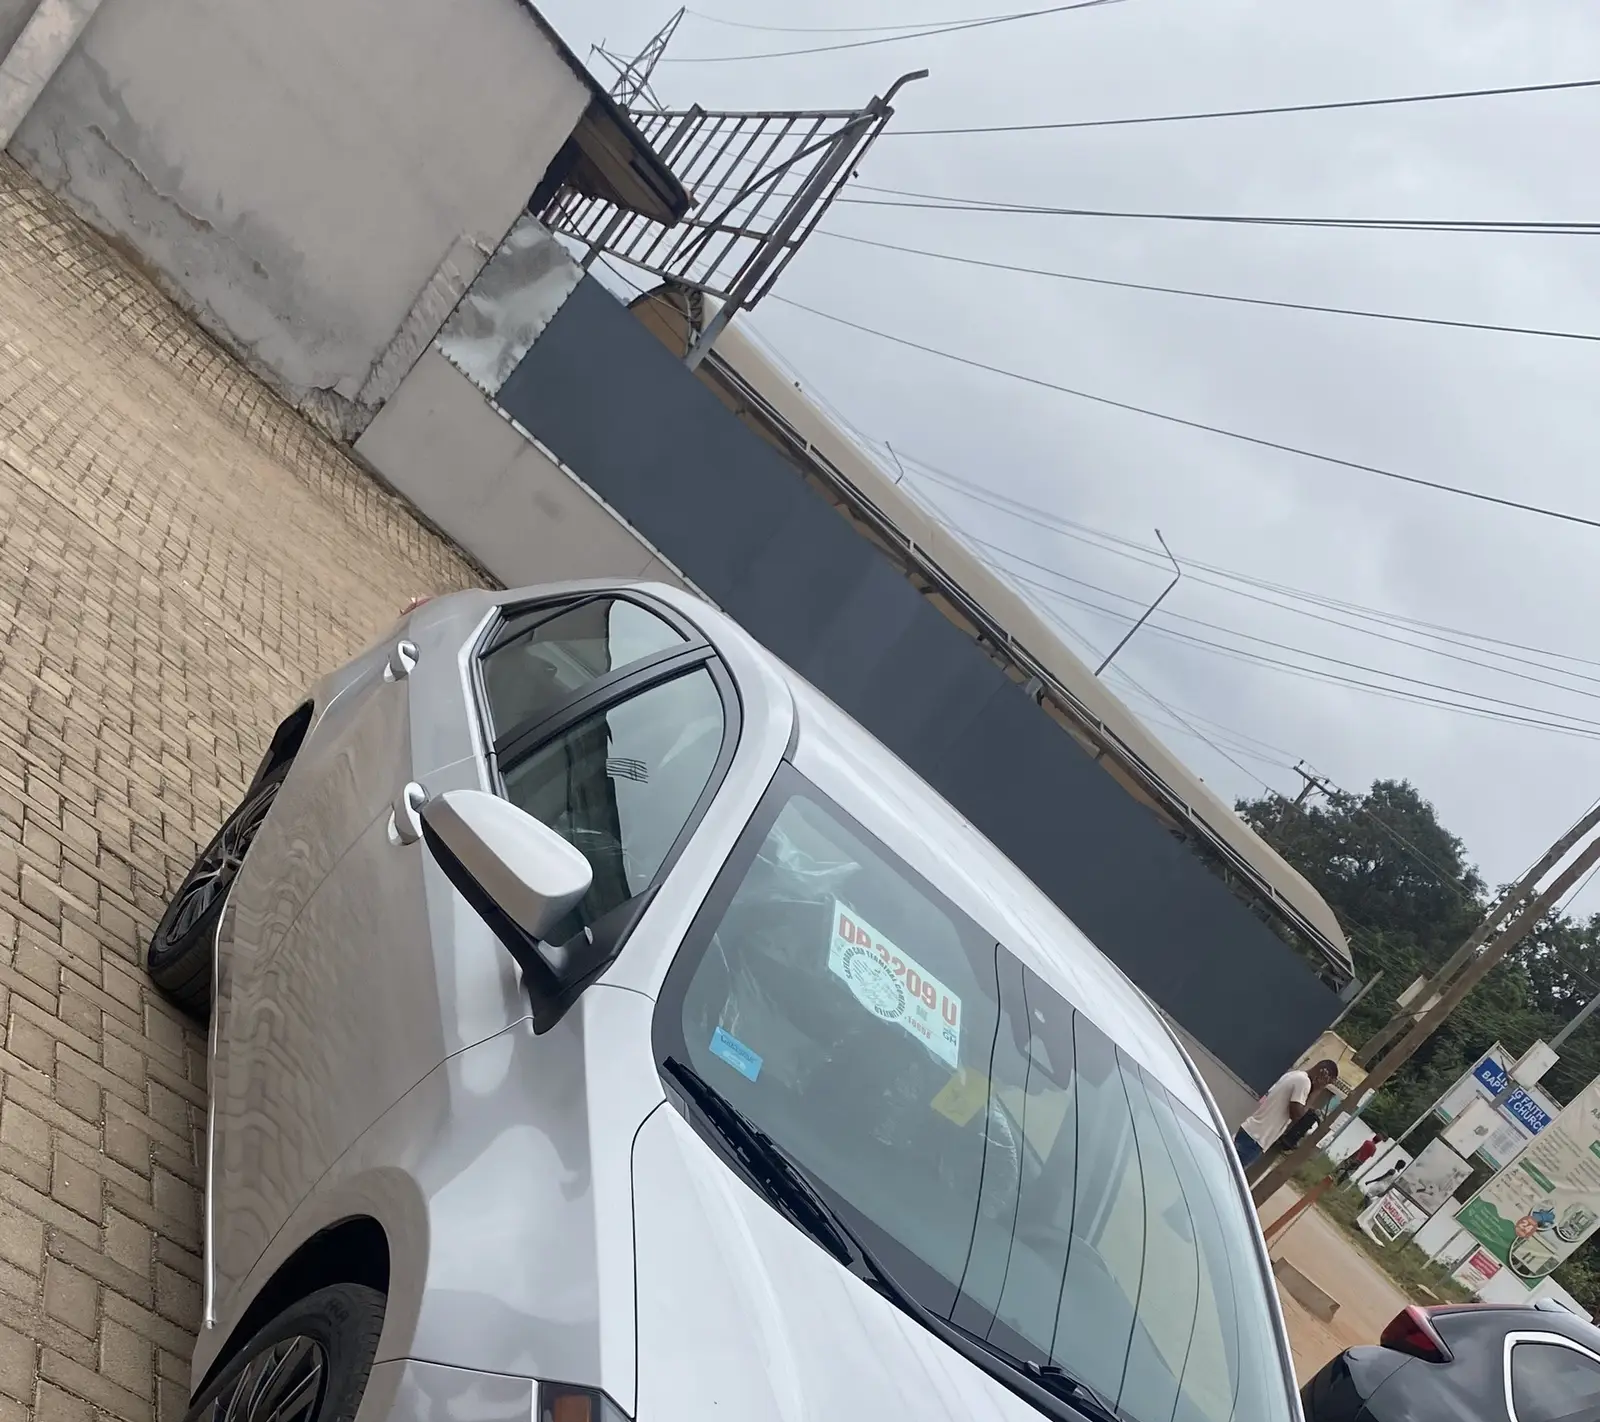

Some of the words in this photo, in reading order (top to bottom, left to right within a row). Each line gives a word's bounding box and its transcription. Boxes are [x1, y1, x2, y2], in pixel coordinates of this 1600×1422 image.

[942, 995, 957, 1026] U
[942, 1030, 957, 1047] GH
[1481, 1070, 1514, 1104] BAPTT
[1520, 1094, 1545, 1120] FAITH
